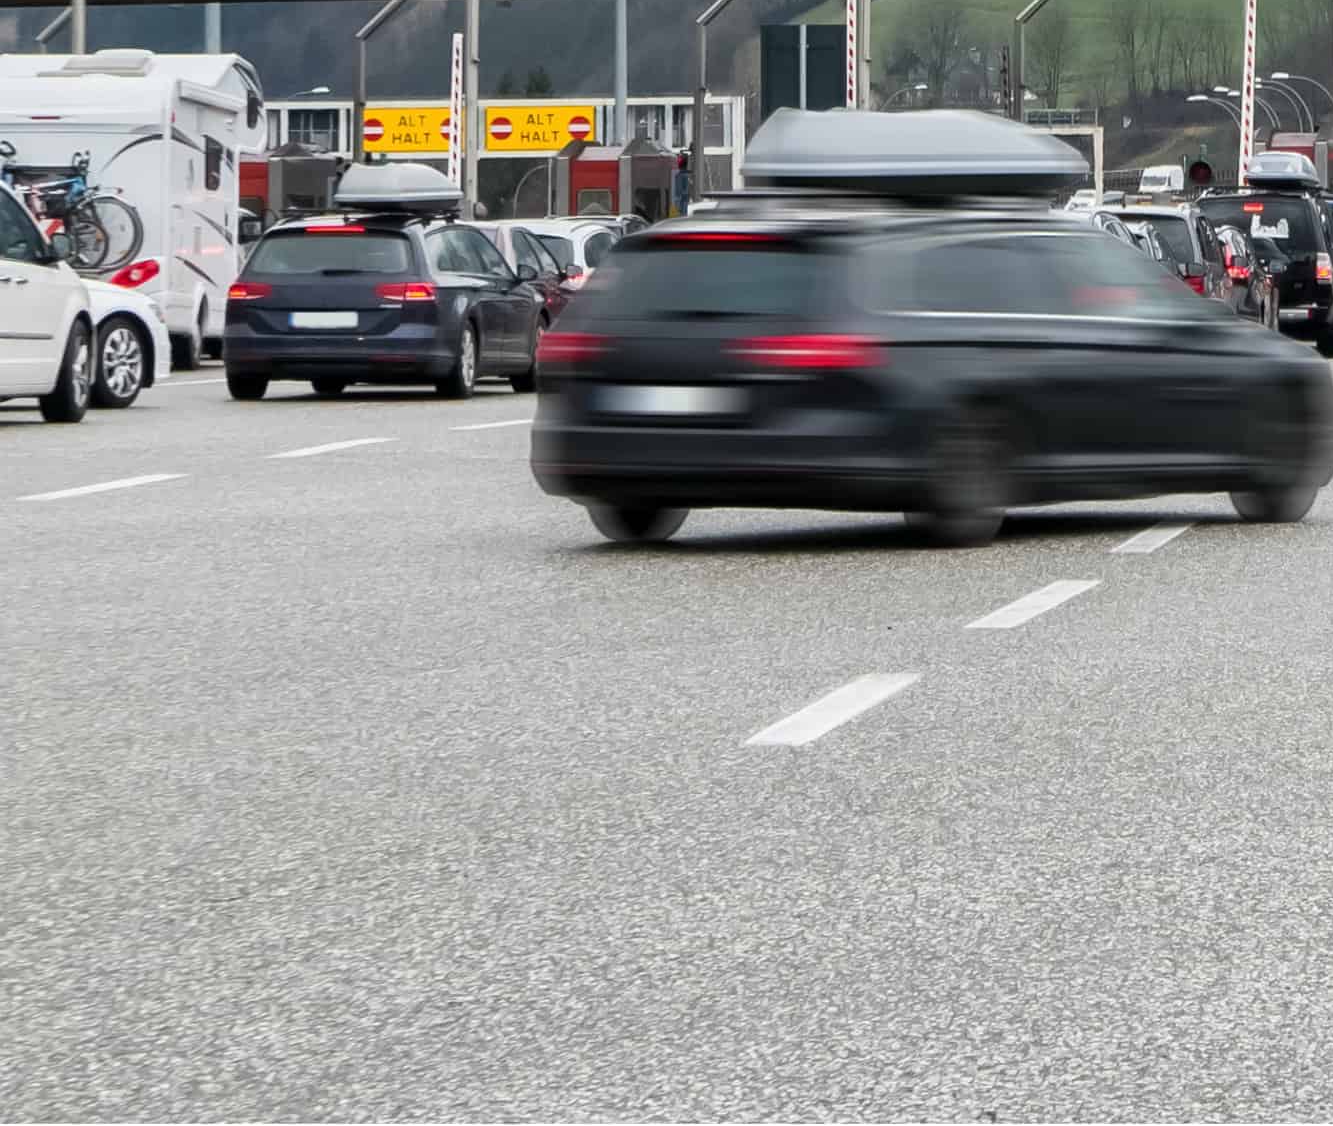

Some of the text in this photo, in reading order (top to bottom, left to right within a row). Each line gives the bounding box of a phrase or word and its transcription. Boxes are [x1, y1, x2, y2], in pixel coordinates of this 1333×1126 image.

[399, 115, 427, 127] ALT
[526, 114, 554, 126] ALT
[392, 133, 431, 145] HALT
[520, 131, 560, 143] HALT
